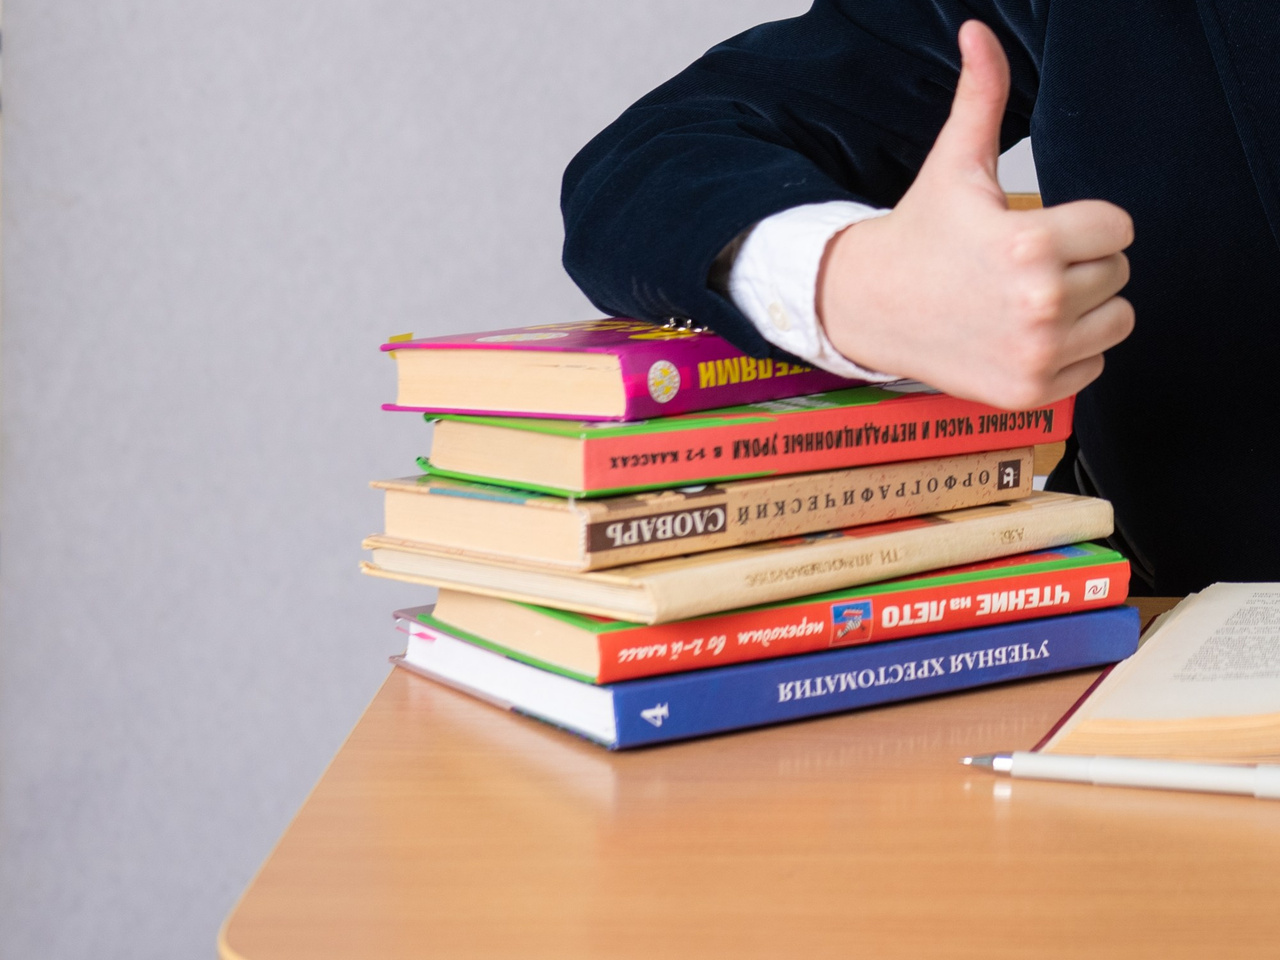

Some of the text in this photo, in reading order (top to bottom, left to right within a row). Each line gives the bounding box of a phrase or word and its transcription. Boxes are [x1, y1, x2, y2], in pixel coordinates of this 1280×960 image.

[698, 355, 814, 389] ТЕЛЯМИ
[782, 421, 917, 454] НЕТРАДИЦИОННЫЕ
[921, 420, 930, 439] И
[935, 416, 974, 439] ЧАСЫ
[685, 448, 706, 461] 1-2
[732, 433, 778, 459] УРОКИ
[610, 450, 679, 469] КЛАССАХ
[606, 470, 991, 547] ОРФОГРАФИЧЕСКИЙ СЛОВАРЬ
[618, 584, 1071, 663] ЧТЕНИЕ на ЛЕТО переходим во 2-й класс
[777, 639, 1050, 703] УЧЕБНАЯ ХРЕСТОМАТИЯ
[640, 702, 669, 728] 4
